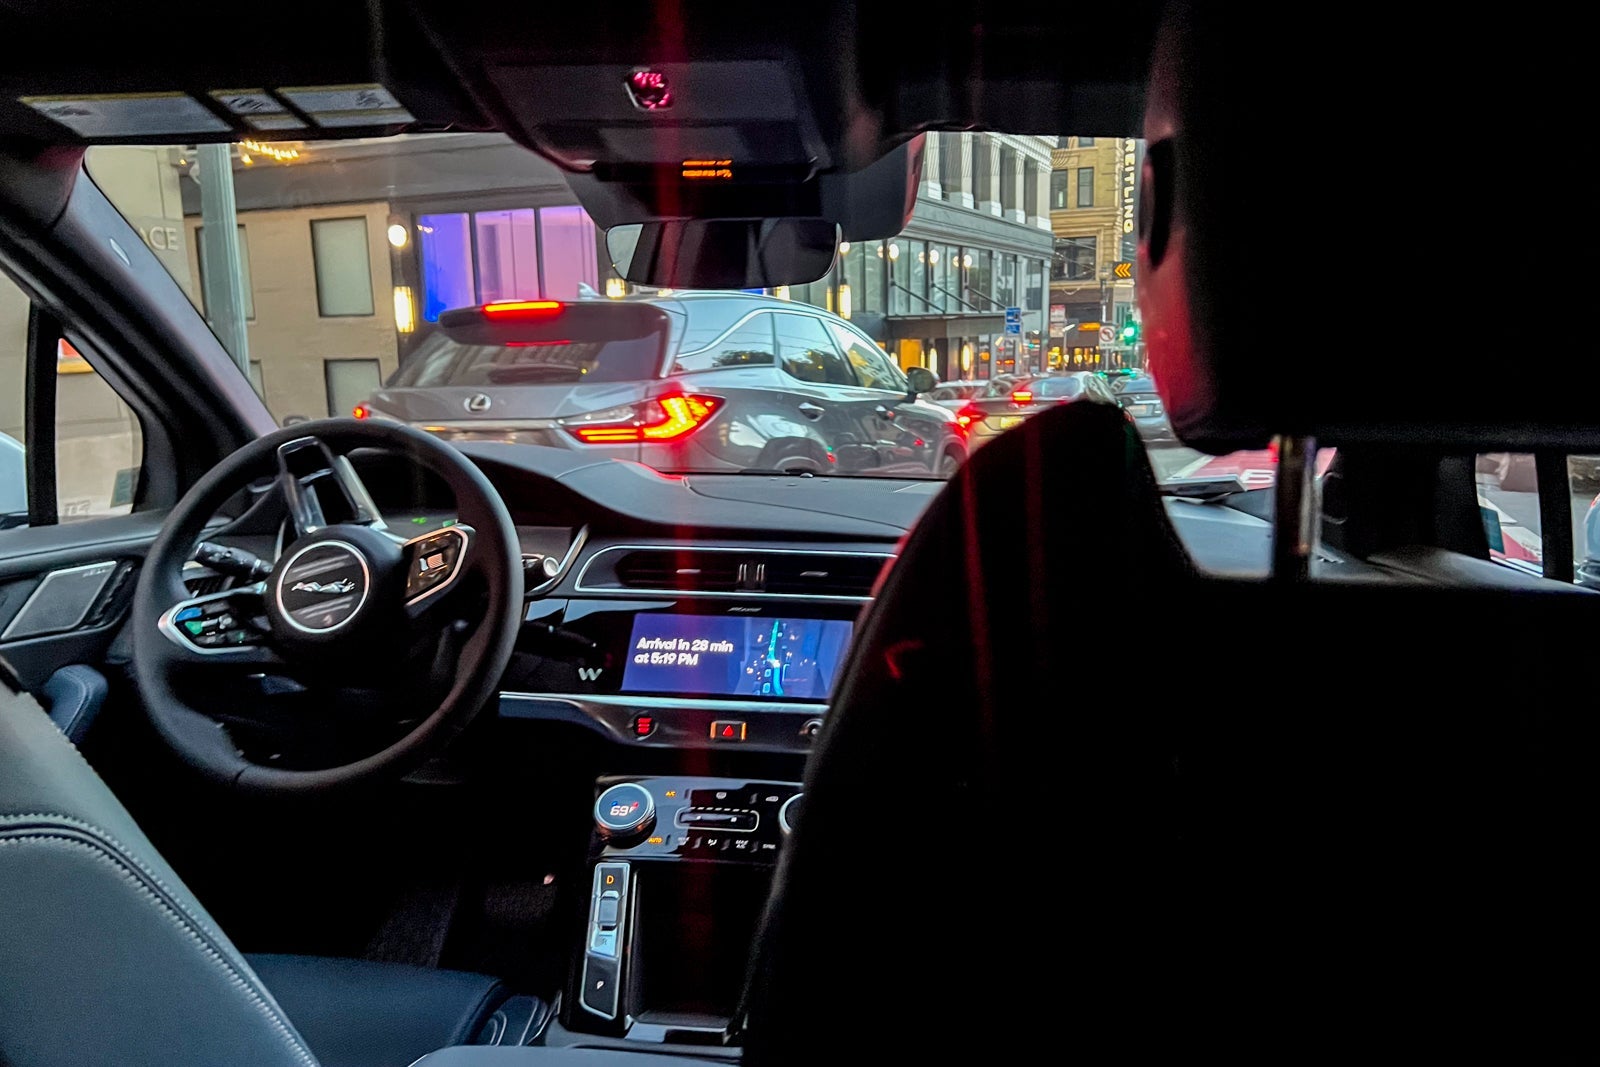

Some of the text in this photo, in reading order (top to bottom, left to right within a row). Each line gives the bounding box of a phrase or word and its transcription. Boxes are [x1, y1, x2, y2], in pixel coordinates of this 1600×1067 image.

[636, 637, 734, 653] Arrival in 28 min
[634, 651, 699, 666] at 5:19 PM
[606, 875, 615, 885] D
